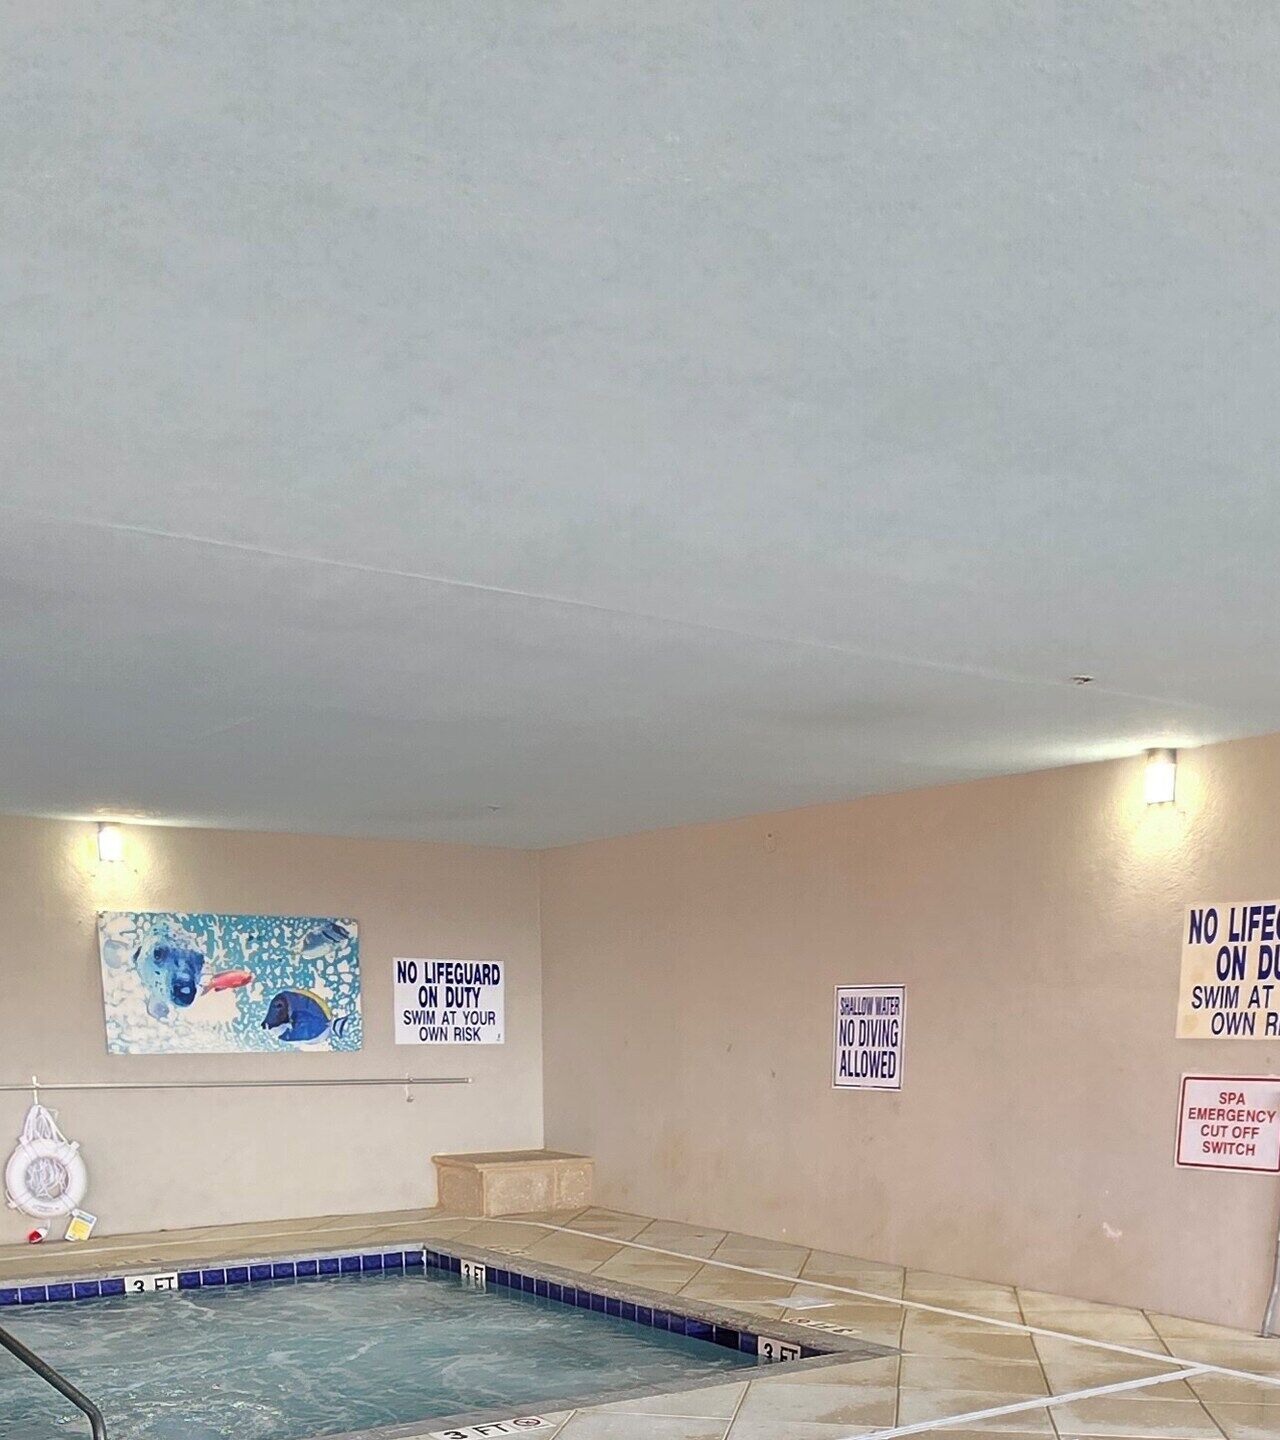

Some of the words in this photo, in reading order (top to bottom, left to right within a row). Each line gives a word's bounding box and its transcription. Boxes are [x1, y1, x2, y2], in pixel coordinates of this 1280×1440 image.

[1189, 908, 1218, 944] NO
[1216, 945, 1246, 981] ON
[397, 961, 418, 984] NO
[424, 962, 500, 985] LIFEGUARD
[418, 985, 438, 1008] ON
[445, 986, 481, 1008] DUTY
[840, 996, 874, 1015] SHALLOW
[875, 996, 900, 1015] WATER
[1191, 985, 1240, 1009] SWIM
[1247, 985, 1274, 1009] AT
[403, 1010, 435, 1025] SWIM
[441, 1011, 457, 1025] AT
[462, 1011, 496, 1025] YOUR
[1211, 1012, 1256, 1036] OWN
[419, 1026, 448, 1042] OWN
[453, 1026, 481, 1042] RISK
[839, 1019, 855, 1047] NO
[858, 1019, 899, 1047] DIVING
[839, 1050, 896, 1078] ALLOWED
[1219, 1092, 1246, 1106] SPA
[1188, 1107, 1277, 1124] EMERGENCY
[1200, 1124, 1228, 1138] CUT
[1232, 1126, 1260, 1140] OFF
[1202, 1141, 1256, 1156] SWITCH
[133, 1280, 145, 1293] 3
[763, 1343, 773, 1359] 3
[443, 1430, 468, 1440] 3
[472, 1423, 509, 1436] FT
